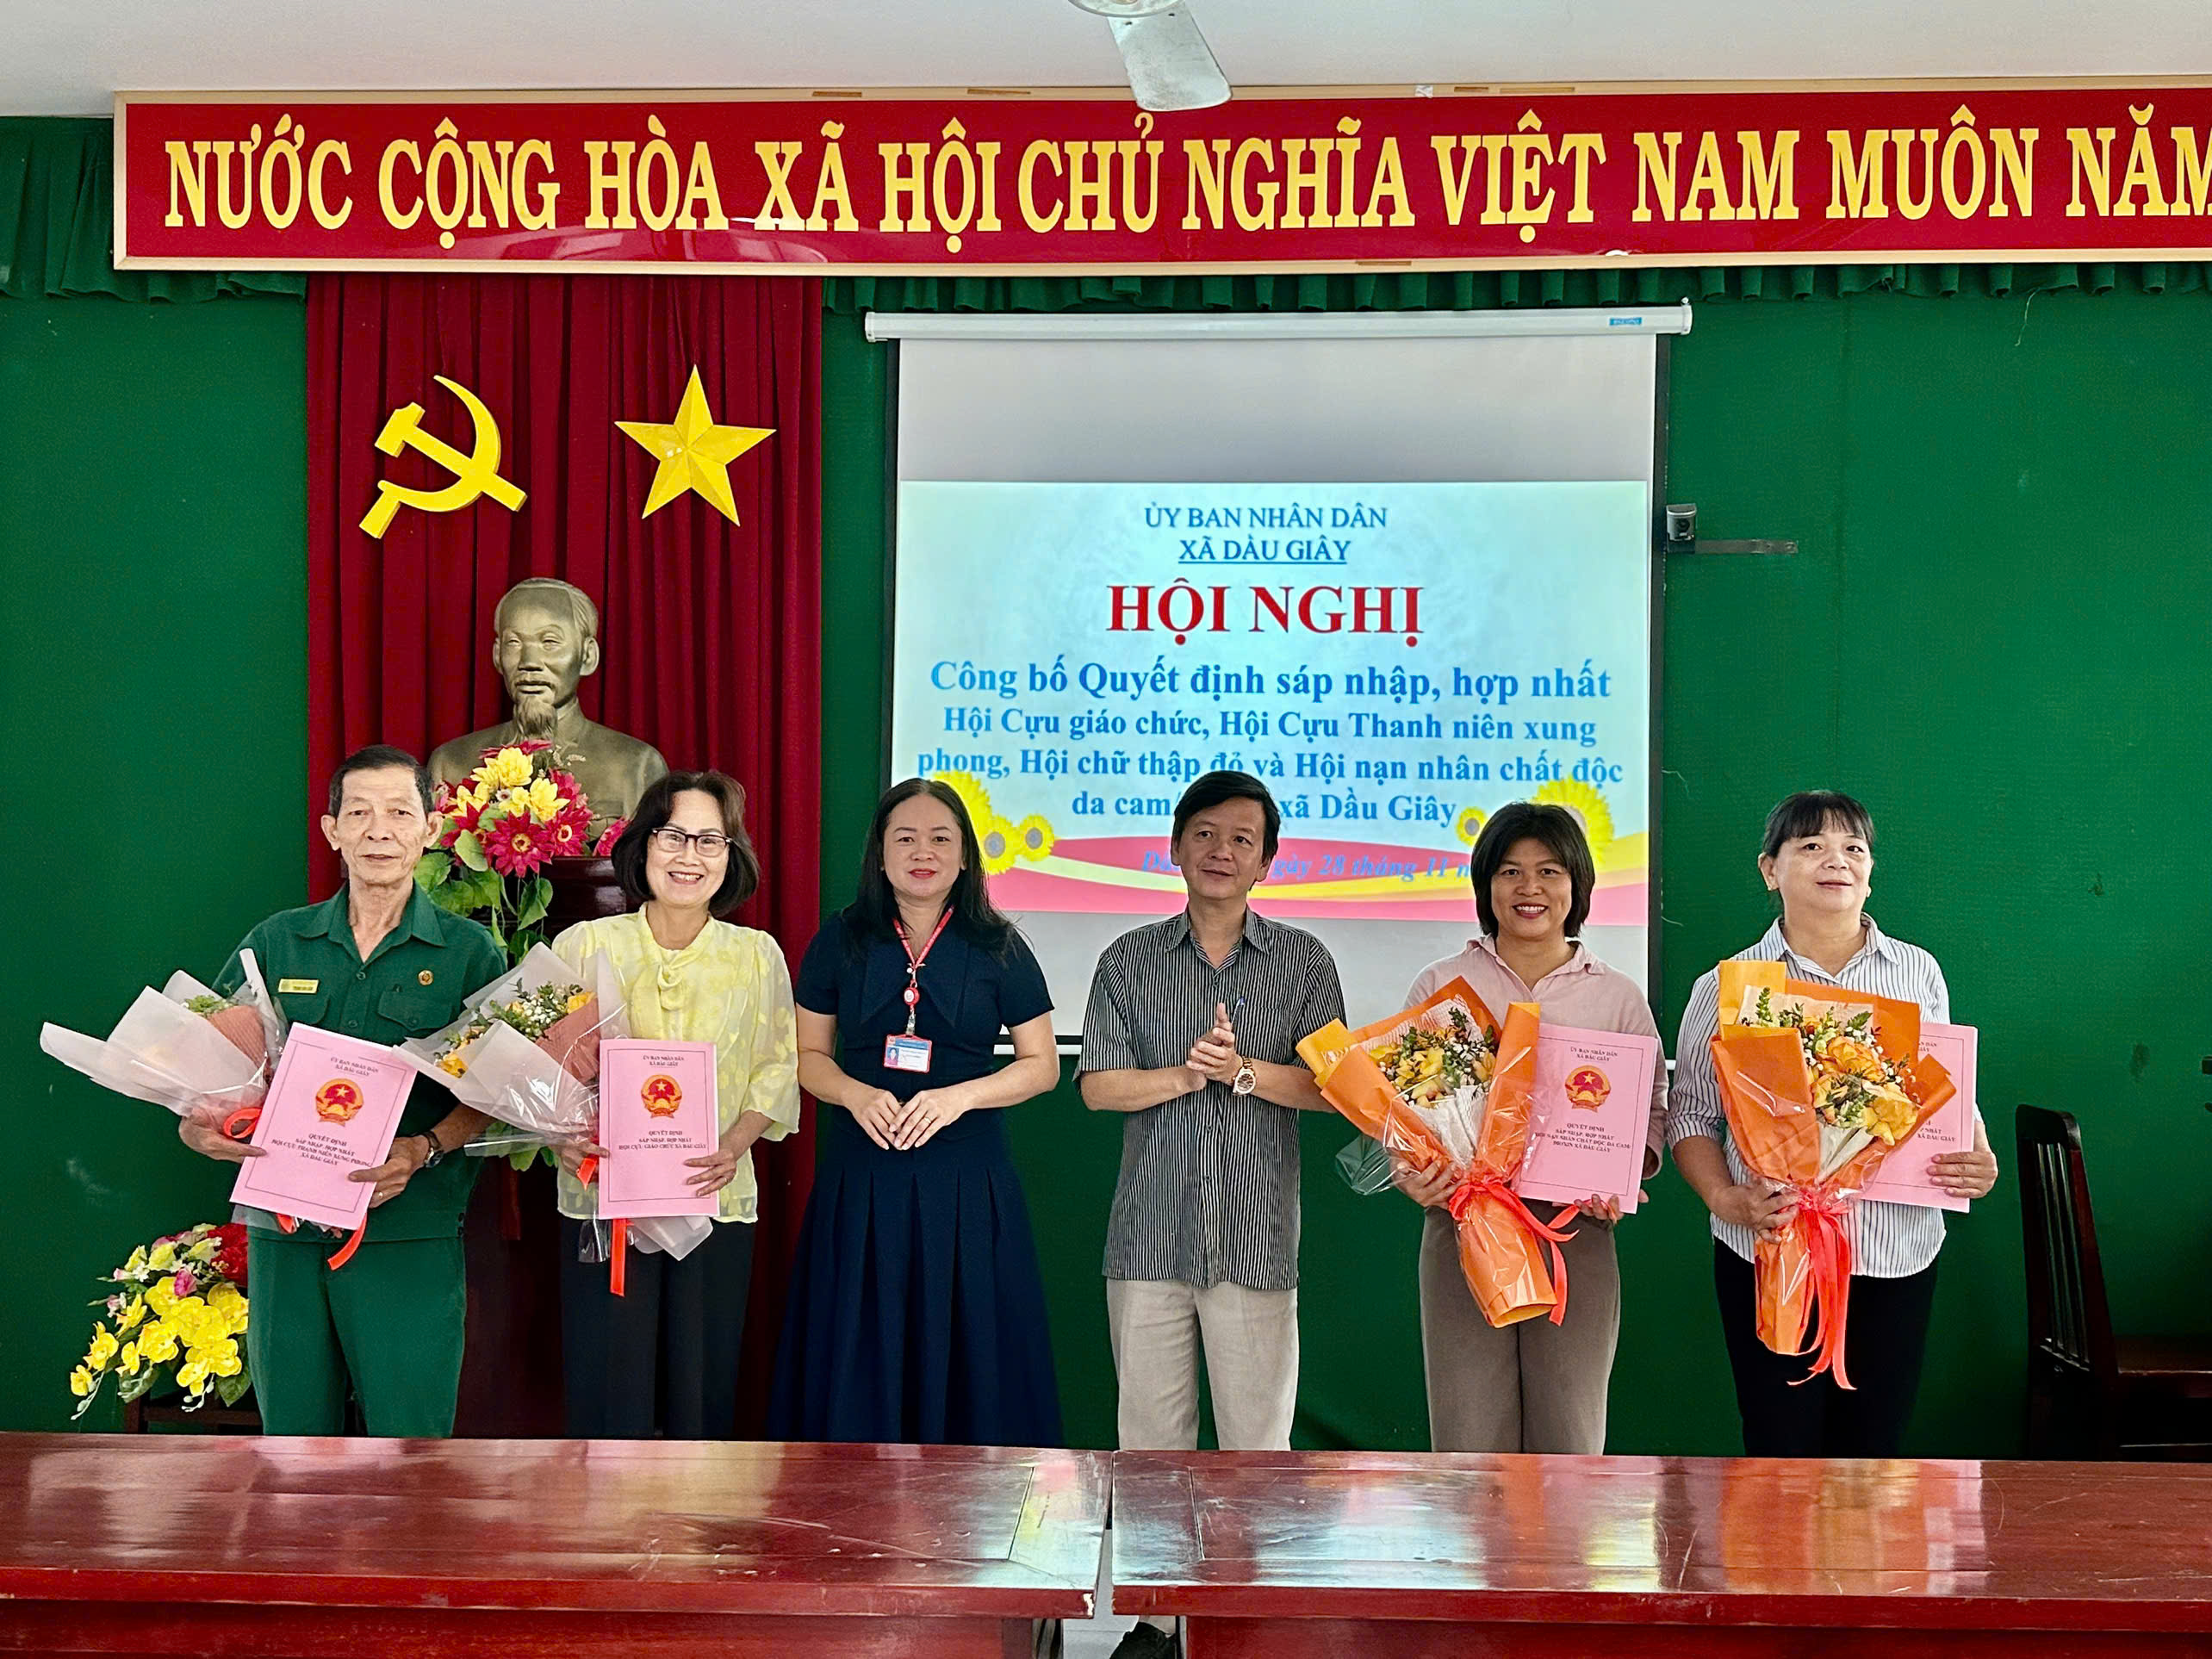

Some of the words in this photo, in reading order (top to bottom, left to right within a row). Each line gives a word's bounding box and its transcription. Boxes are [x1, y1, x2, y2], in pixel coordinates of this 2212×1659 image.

[165, 113, 353, 229] NƯỚC
[378, 116, 561, 249] CỘNG
[584, 114, 729, 232] HÒA
[754, 121, 859, 233] XÃ
[879, 116, 1002, 253] HỘI
[1018, 112, 1165, 234] CHỦ
[1182, 116, 1415, 231] NGHĨA
[1431, 109, 1606, 243] VIỆT
[1632, 129, 1799, 222] NAM
[1826, 103, 2039, 221] MUÔN
[1187, 507, 1242, 528] BAN
[1248, 503, 1324, 528] NHÂN
[1331, 501, 1388, 529] DÂN
[1178, 536, 1216, 561] XÃ
[1286, 534, 1351, 562] GIÂY
[1106, 577, 1231, 646] HỘI
[1248, 585, 1425, 648] NGHỊ
[930, 660, 1018, 699] Công
[1028, 655, 1068, 693] bố
[1078, 655, 1180, 700] Quyết
[1190, 664, 1265, 702] định
[1277, 665, 1333, 703] sáp
[1345, 665, 1441, 704] nhập,
[1452, 667, 1519, 705] hợp
[1531, 659, 1612, 698] nhất
[943, 706, 991, 738] Hội
[1001, 708, 1059, 740] Cựu
[1069, 710, 1127, 741] giáo
[1135, 710, 1210, 741] chức,
[1220, 711, 1269, 743] Hội
[1278, 711, 1339, 743] Cựu
[1348, 712, 1442, 738] Thanh
[1452, 713, 1513, 740] niên
[1525, 720, 1597, 748] xung
[917, 748, 1010, 779] phong,
[1020, 749, 1069, 780] Hội
[1078, 750, 1130, 775] chữ
[1138, 750, 1202, 783] thập
[1253, 751, 1284, 777] và
[1295, 753, 1345, 785] Hội
[1355, 760, 1407, 786] nạn
[1417, 754, 1497, 781] nhân
[1500, 749, 1563, 784] chất
[1572, 756, 1624, 790] độc
[1072, 791, 1105, 816] da
[1279, 793, 1310, 818] xã
[1319, 786, 1378, 820] Dầu
[1388, 793, 1457, 829] Giây
[1271, 852, 1313, 880] gày
